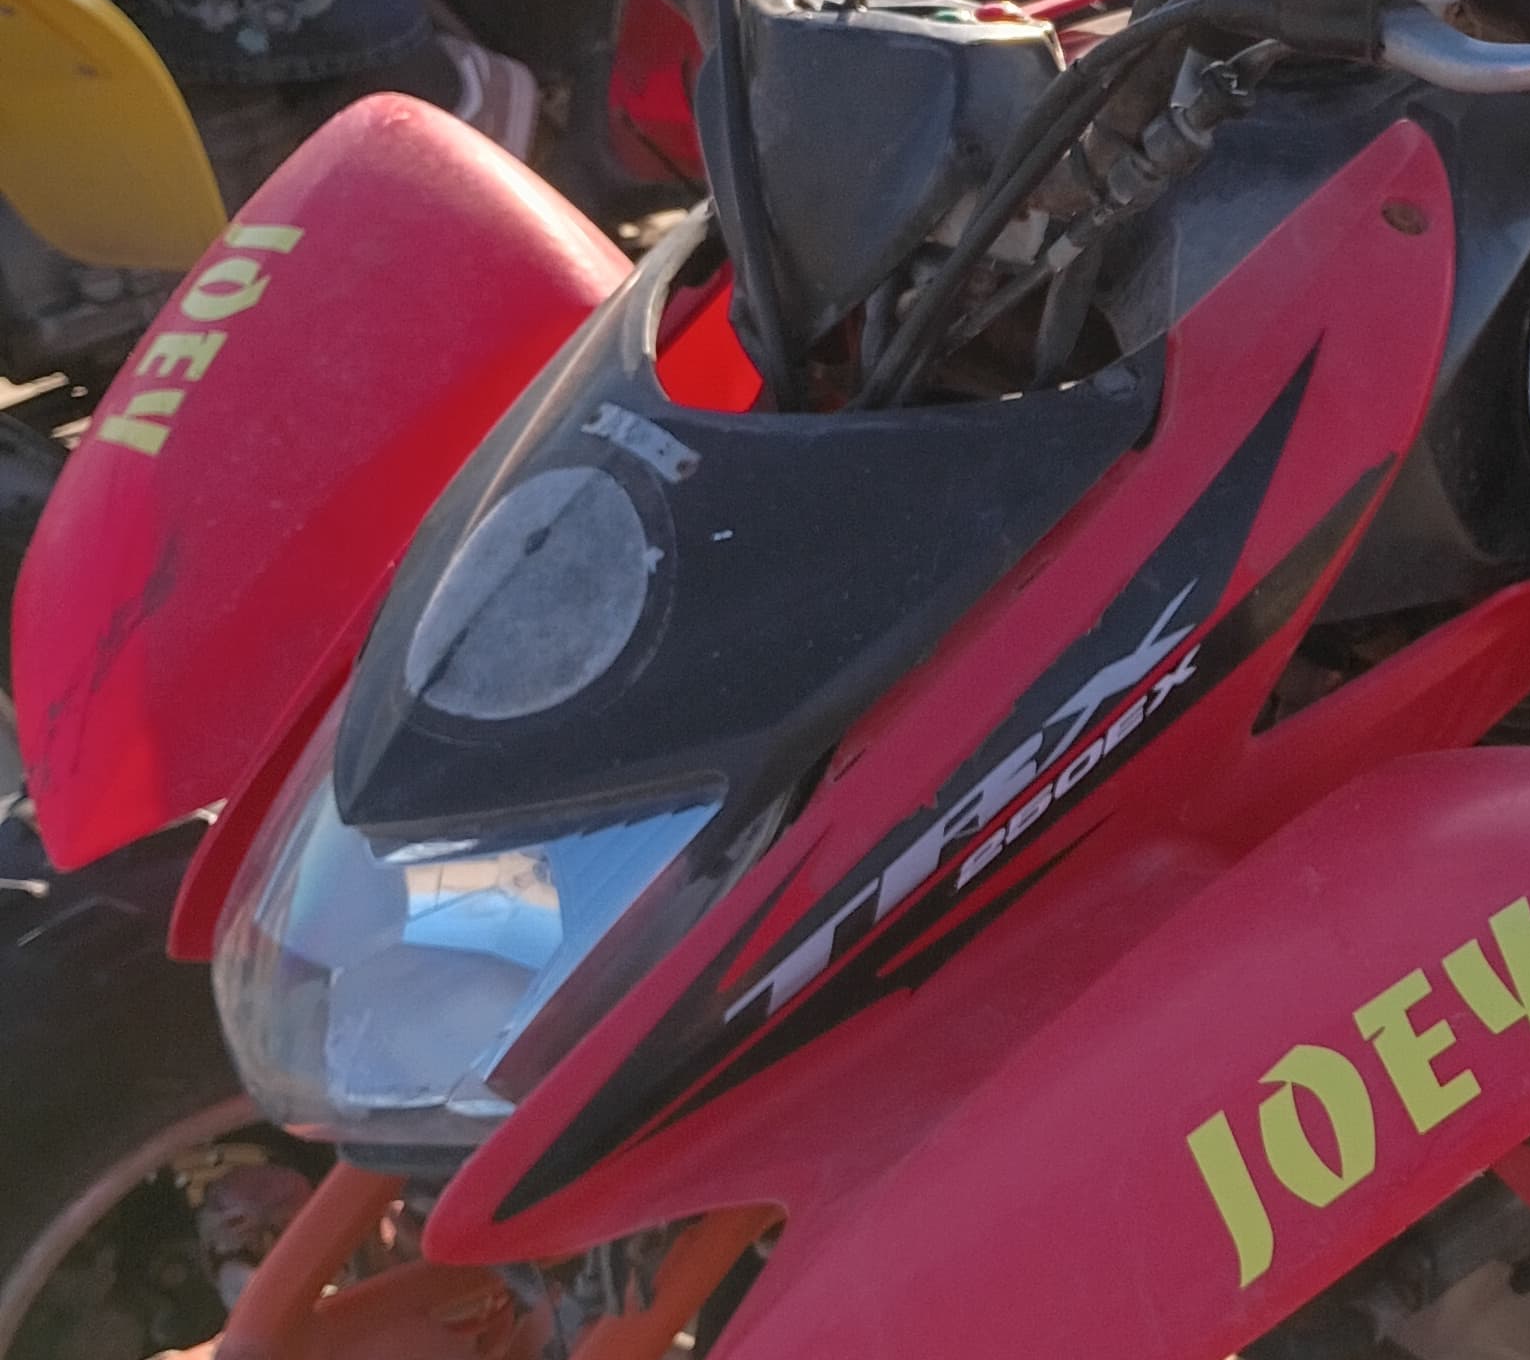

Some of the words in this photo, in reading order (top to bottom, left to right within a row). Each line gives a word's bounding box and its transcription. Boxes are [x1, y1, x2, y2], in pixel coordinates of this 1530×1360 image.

[99, 225, 304, 456] JOEY
[724, 578, 1198, 1024] TRX
[954, 644, 1202, 892] 250EX
